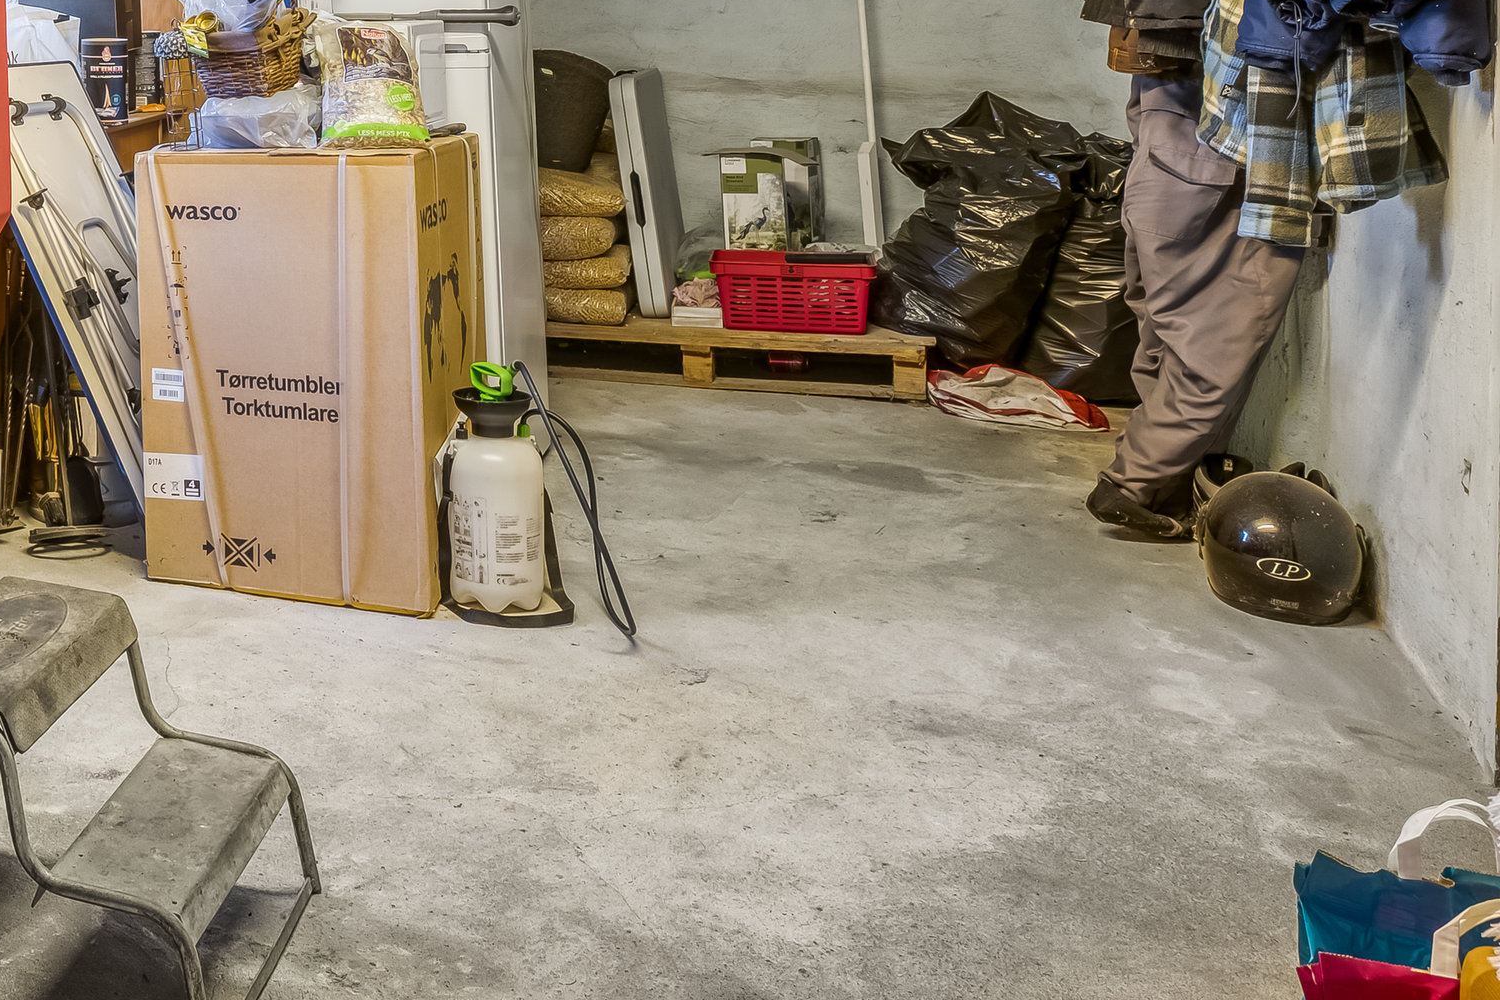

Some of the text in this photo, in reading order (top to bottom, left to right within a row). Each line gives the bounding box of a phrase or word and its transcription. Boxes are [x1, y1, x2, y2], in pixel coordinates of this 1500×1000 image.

[165, 205, 238, 221] wasco
[215, 369, 340, 395] Tørretumbler
[221, 396, 339, 423] Torktumlare
[1270, 561, 1300, 578] LP
